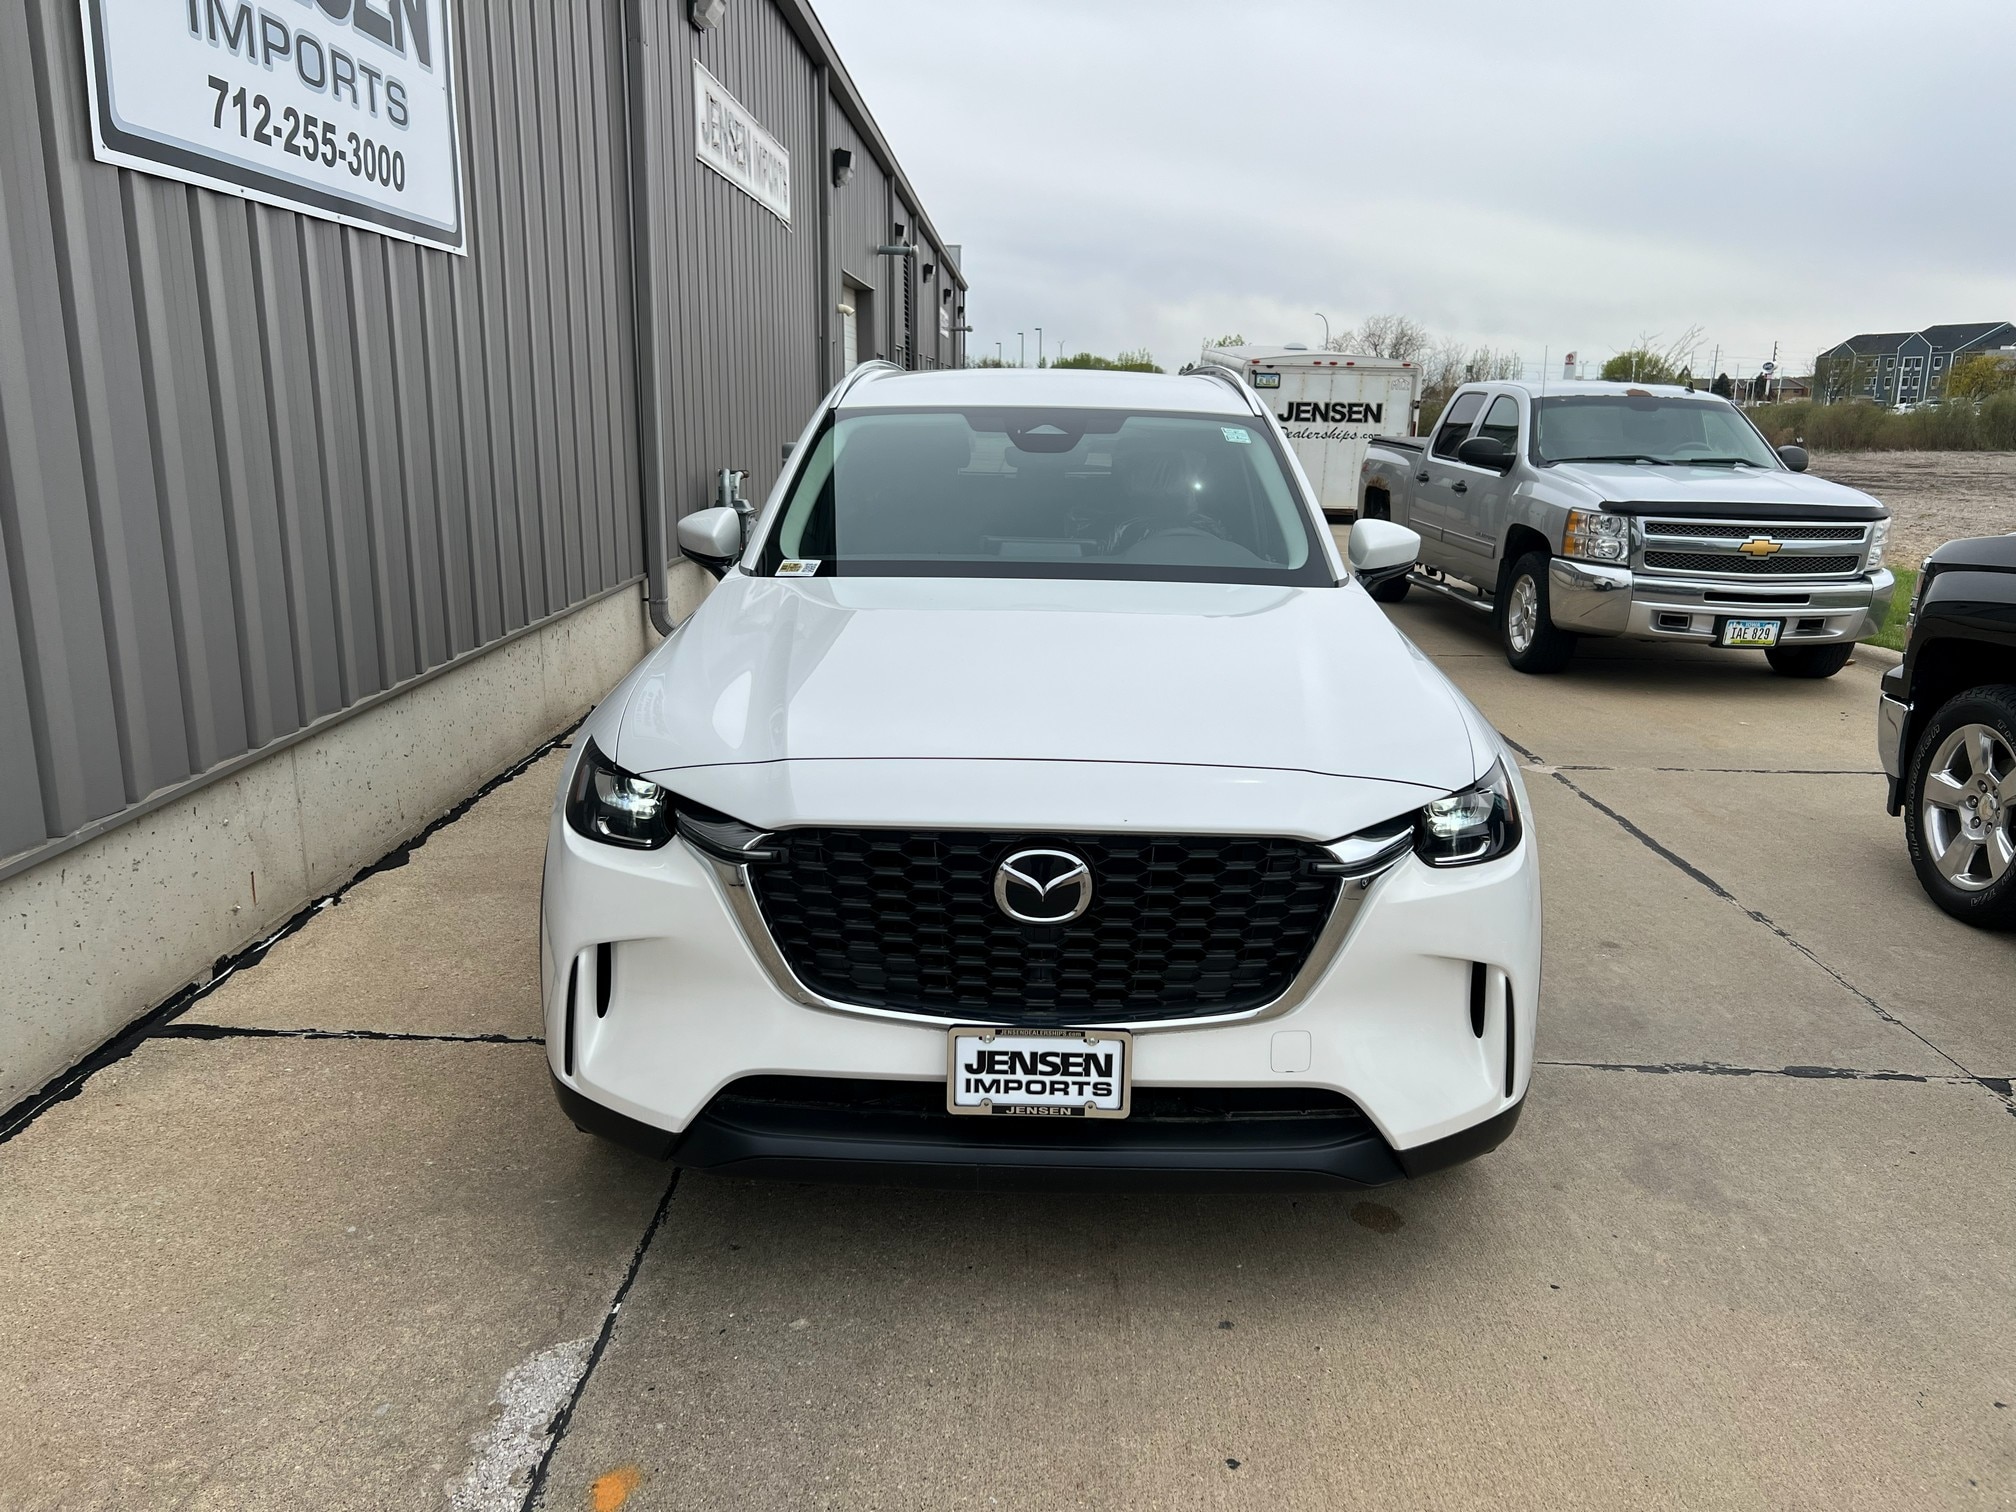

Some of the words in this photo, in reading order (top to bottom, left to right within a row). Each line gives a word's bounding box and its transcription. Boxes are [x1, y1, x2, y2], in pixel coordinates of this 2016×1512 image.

[189, 0, 408, 127] IMPORTS
[208, 75, 405, 191] 712-255-3000
[1278, 402, 1382, 423] JENSEN
[1731, 627, 1749, 639] IAE
[1752, 627, 1770, 639] 829
[964, 1050, 1113, 1078] JENSEN
[965, 1078, 1112, 1097] IMPORTS
[1005, 1106, 1071, 1116] JENSEN
